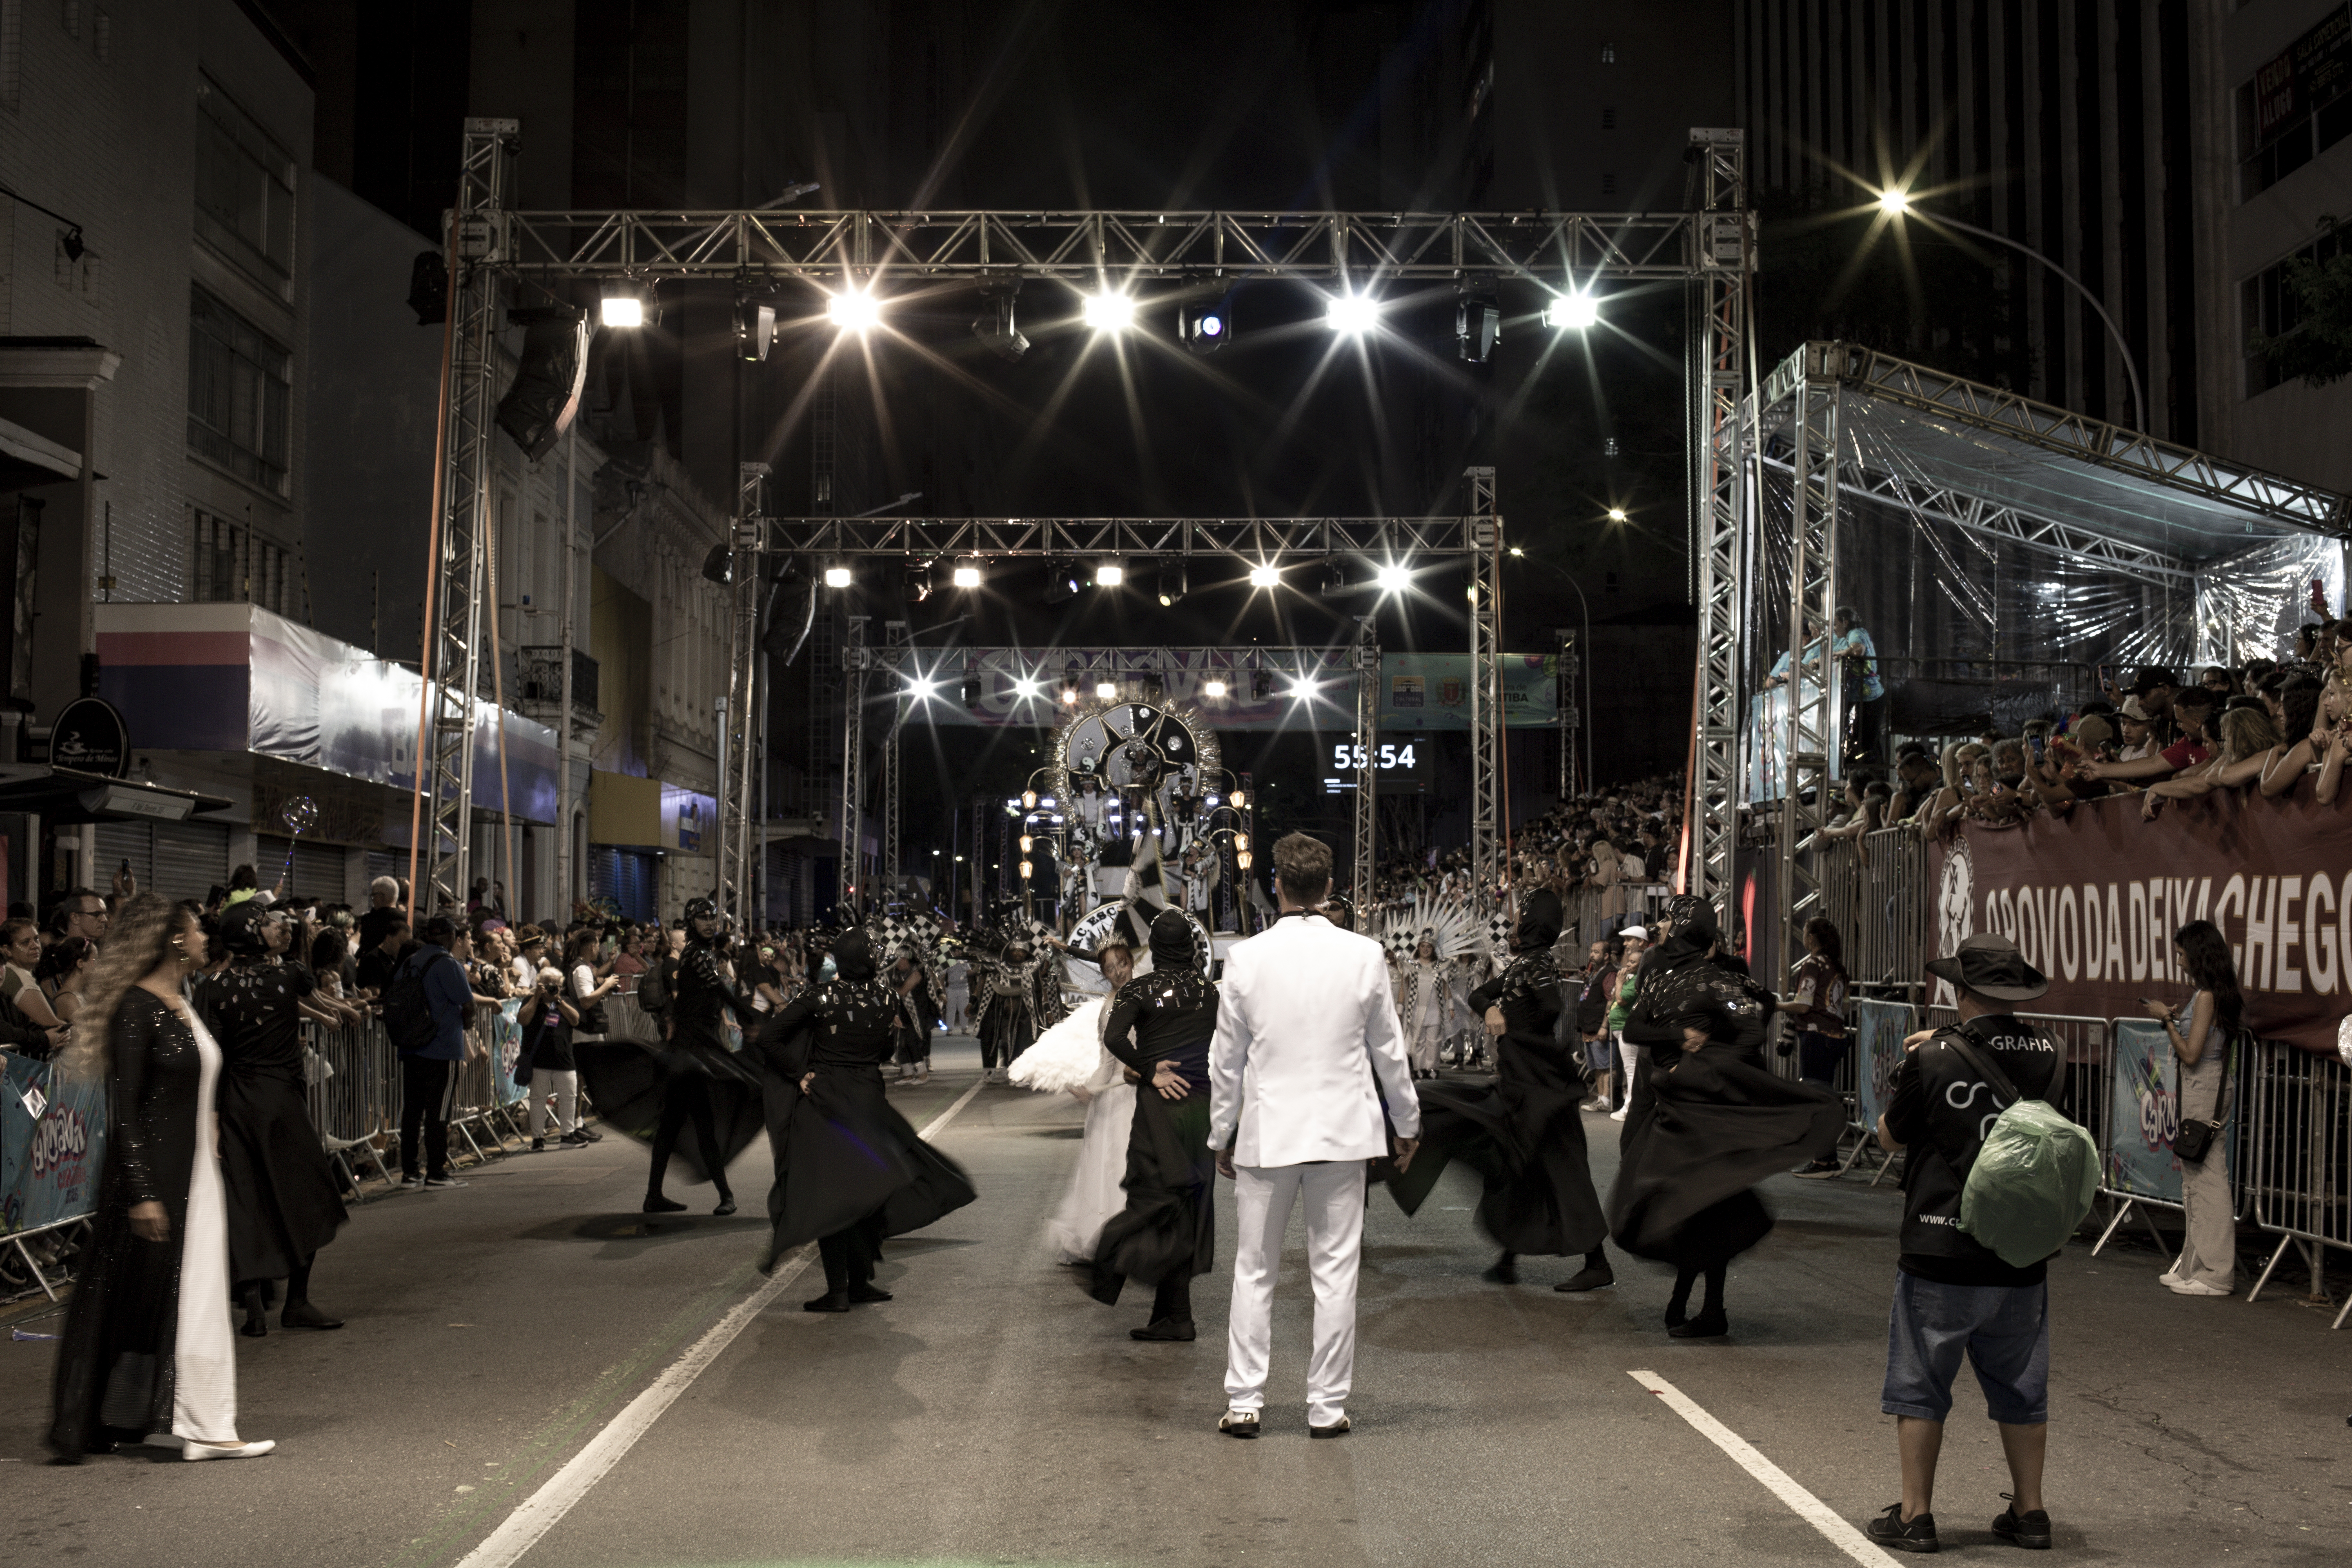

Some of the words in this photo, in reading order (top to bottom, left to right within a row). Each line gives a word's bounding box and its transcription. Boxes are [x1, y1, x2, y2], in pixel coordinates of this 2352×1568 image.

[2259, 55, 2291, 96] VENDO
[2263, 87, 2292, 129] ALUGO
[1334, 744, 1416, 769] 55:54
[2083, 882, 2125, 982] DA
